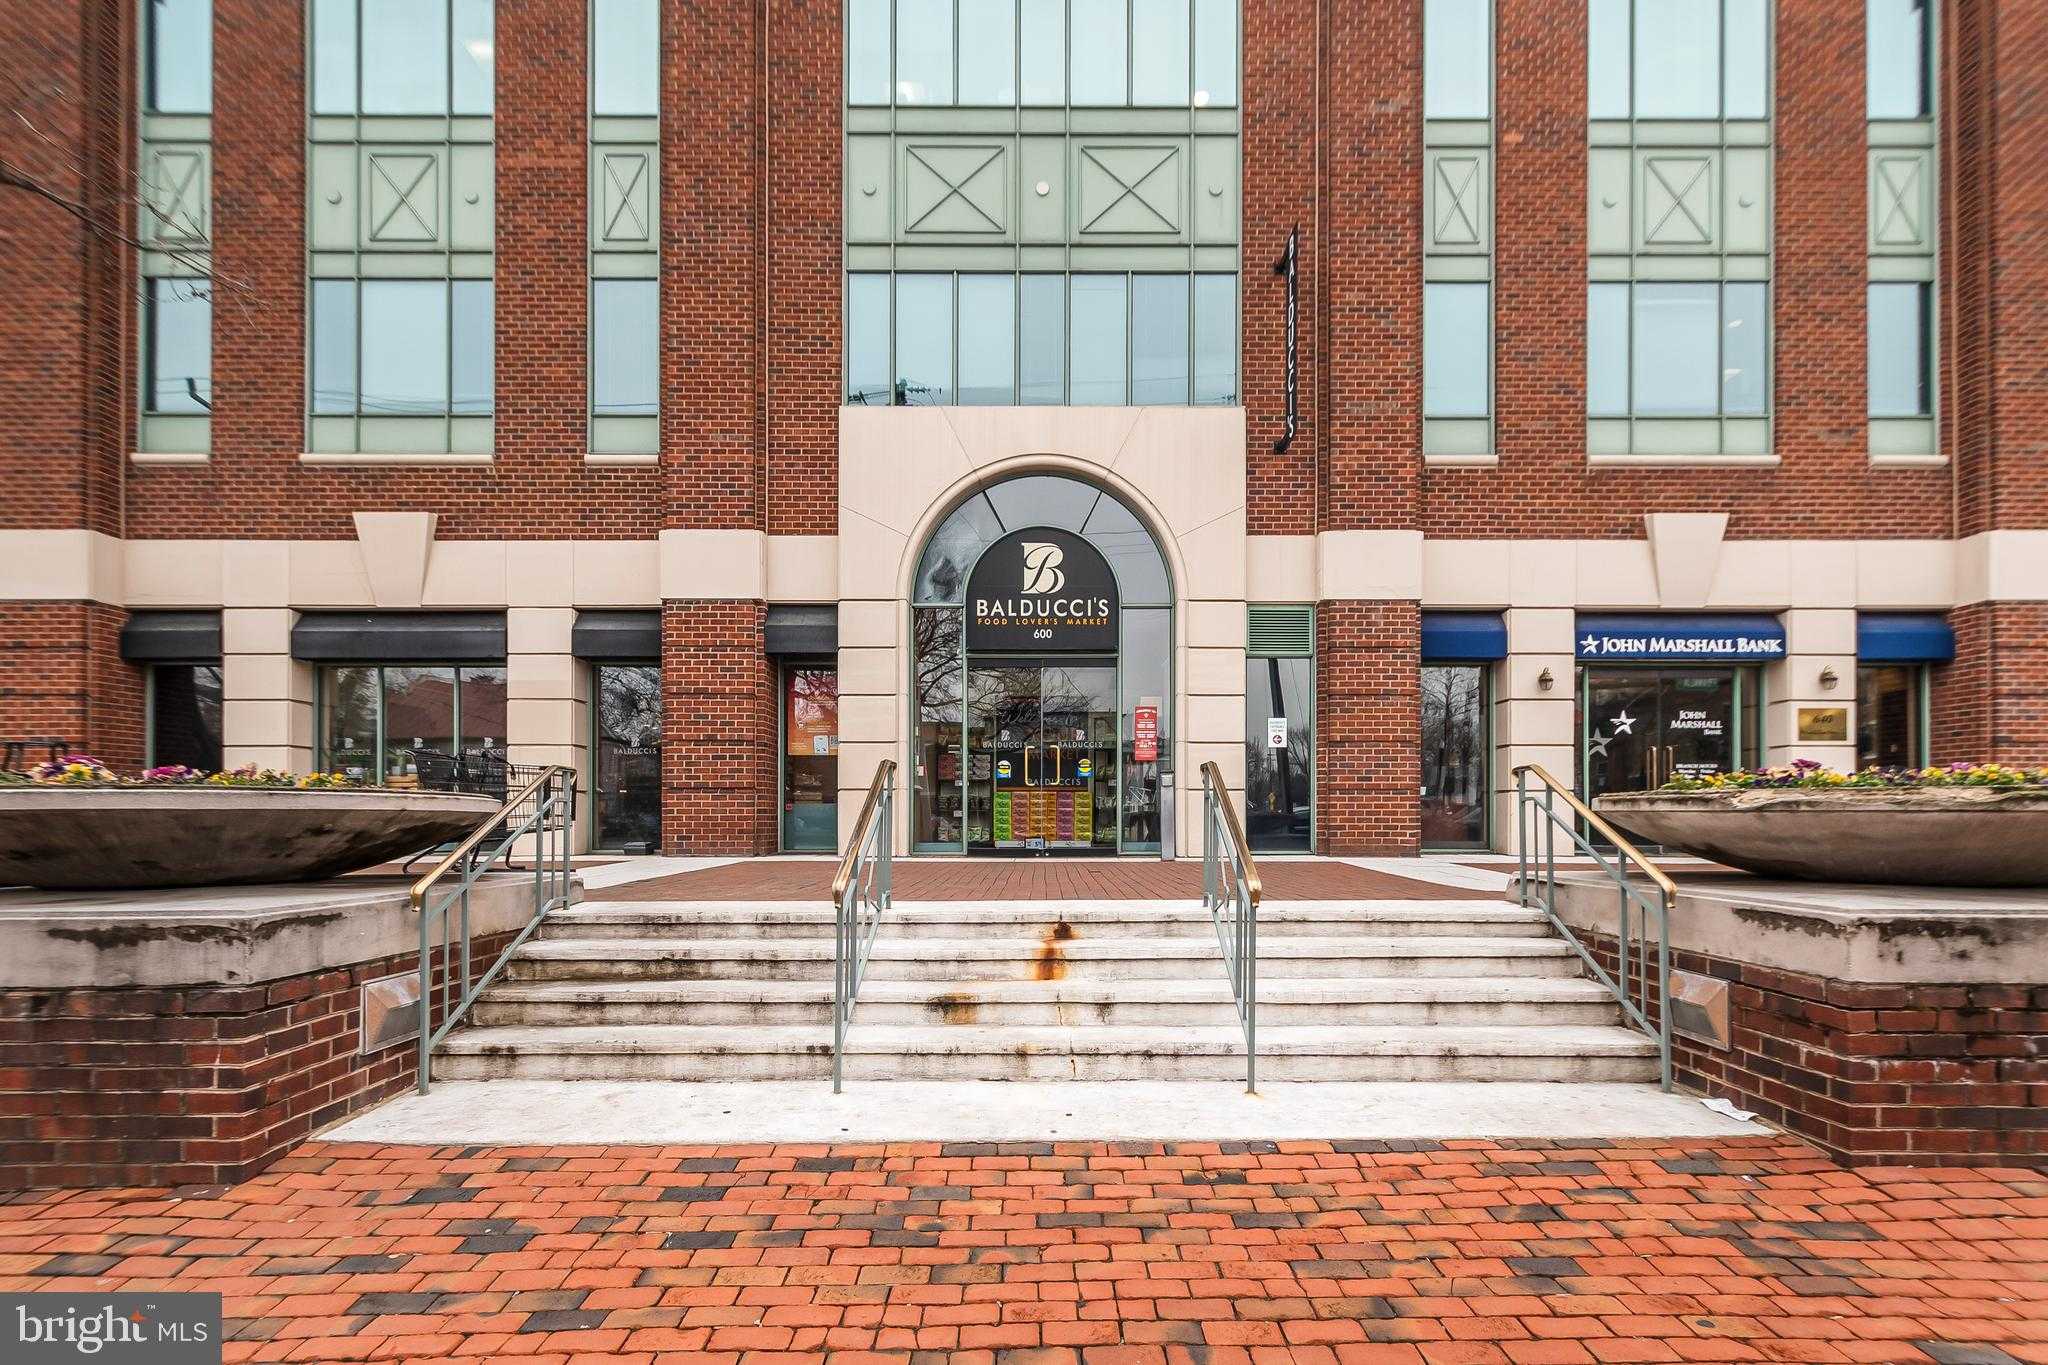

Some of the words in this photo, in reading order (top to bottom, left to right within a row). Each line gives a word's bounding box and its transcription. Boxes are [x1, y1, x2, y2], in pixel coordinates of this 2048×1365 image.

[976, 597, 1109, 617] BALDUCCI'S
[977, 617, 1008, 626] FOOD
[1066, 617, 1108, 626] MARKET
[1033, 629, 1053, 639] 600
[1600, 636, 1647, 654] JOHN
[1649, 637, 1735, 653] MARSHALL
[1736, 637, 1783, 653] BANK
[1679, 710, 1706, 720] JOHN
[1670, 720, 1723, 729] MARSHALL
